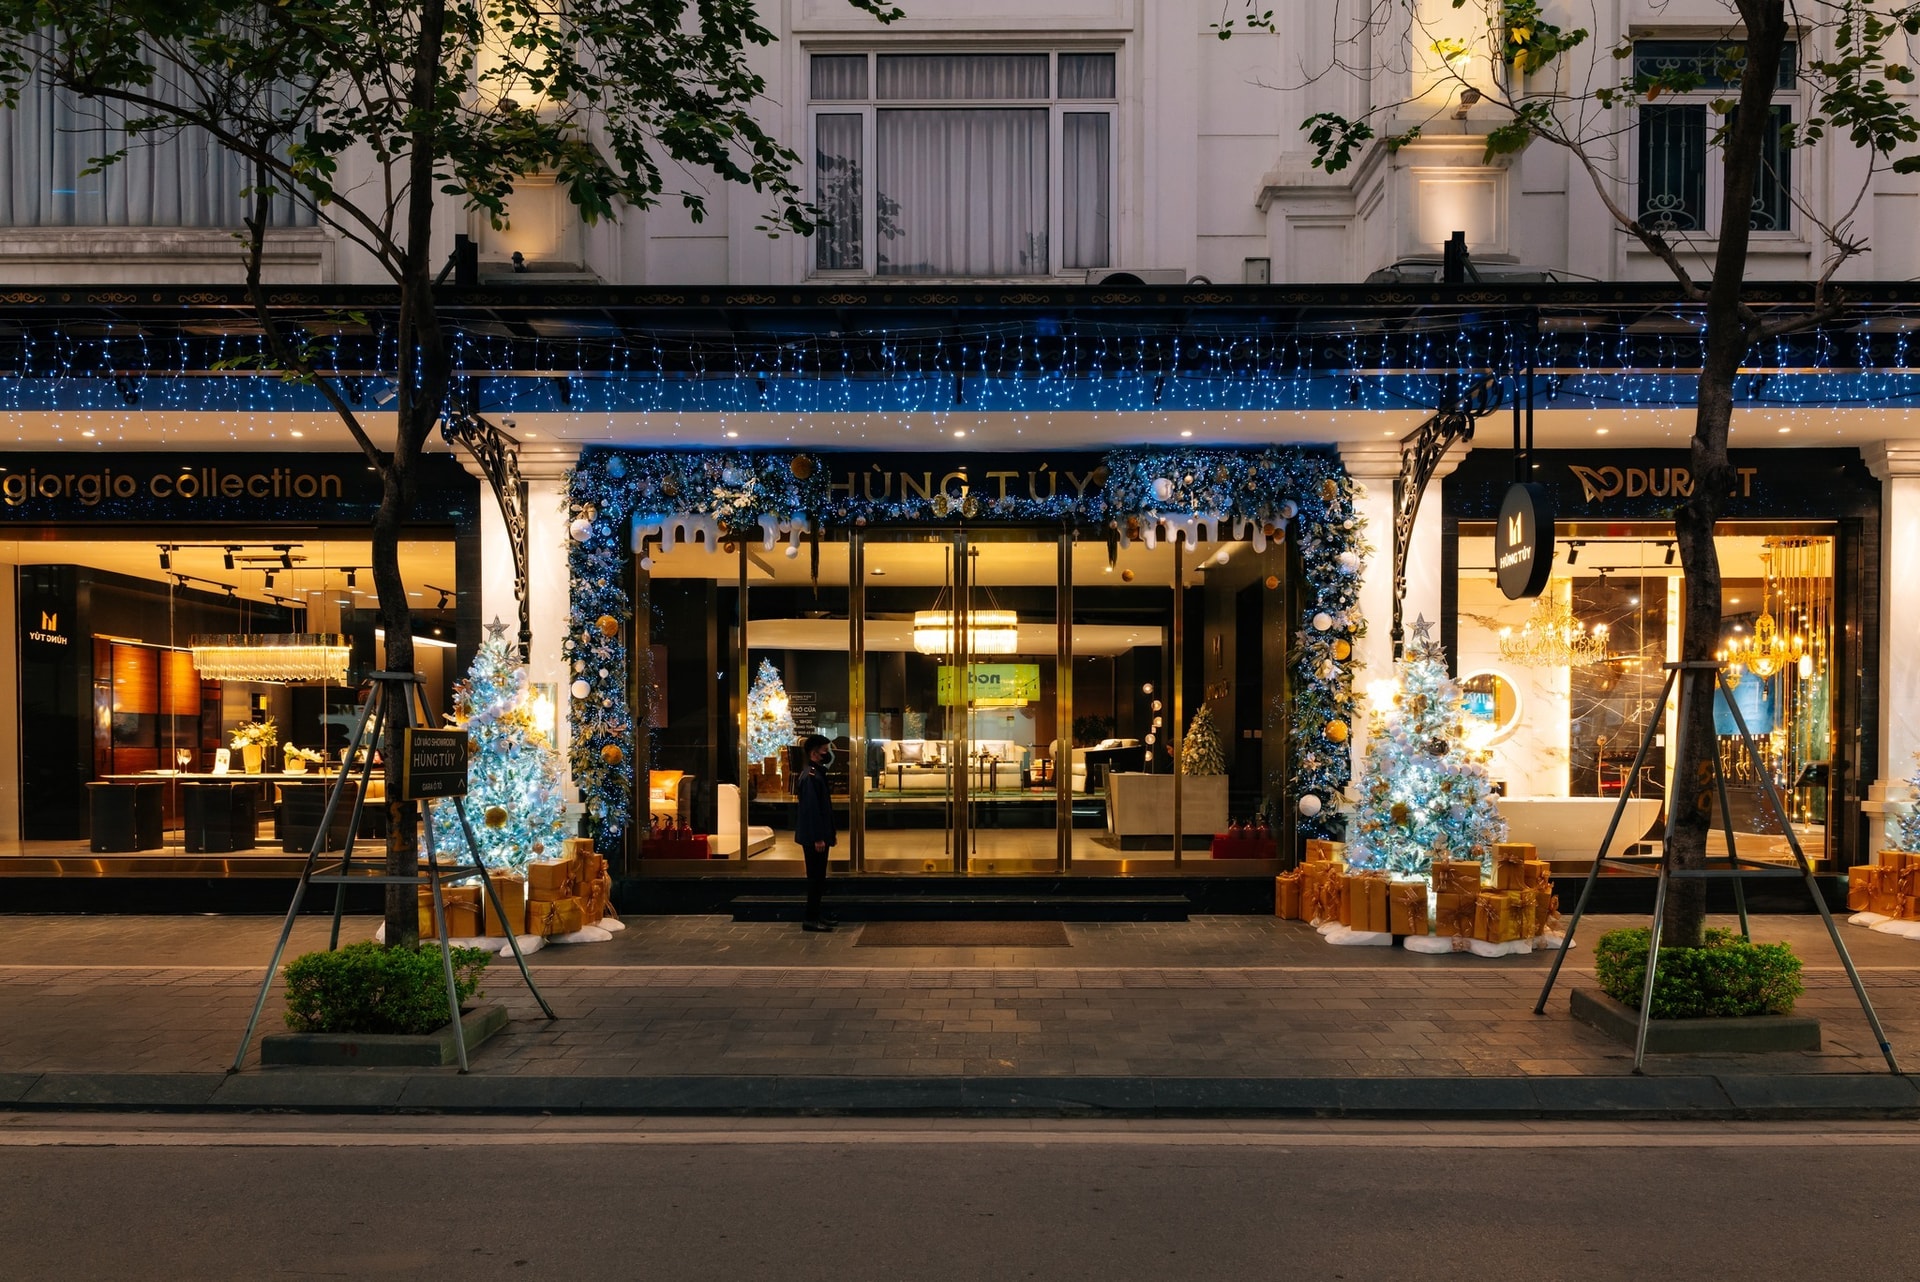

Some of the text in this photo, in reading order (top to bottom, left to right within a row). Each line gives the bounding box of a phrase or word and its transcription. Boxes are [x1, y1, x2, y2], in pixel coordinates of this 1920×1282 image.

[2, 468, 343, 506] giorgio collection
[829, 462, 1095, 502] HÙNG TÚY
[1626, 467, 1758, 498] DURT
[1500, 545, 1531, 569] HÙNG TÚY
[431, 737, 456, 747] SHOWROOM
[413, 749, 456, 768] HÙNG TÚY
